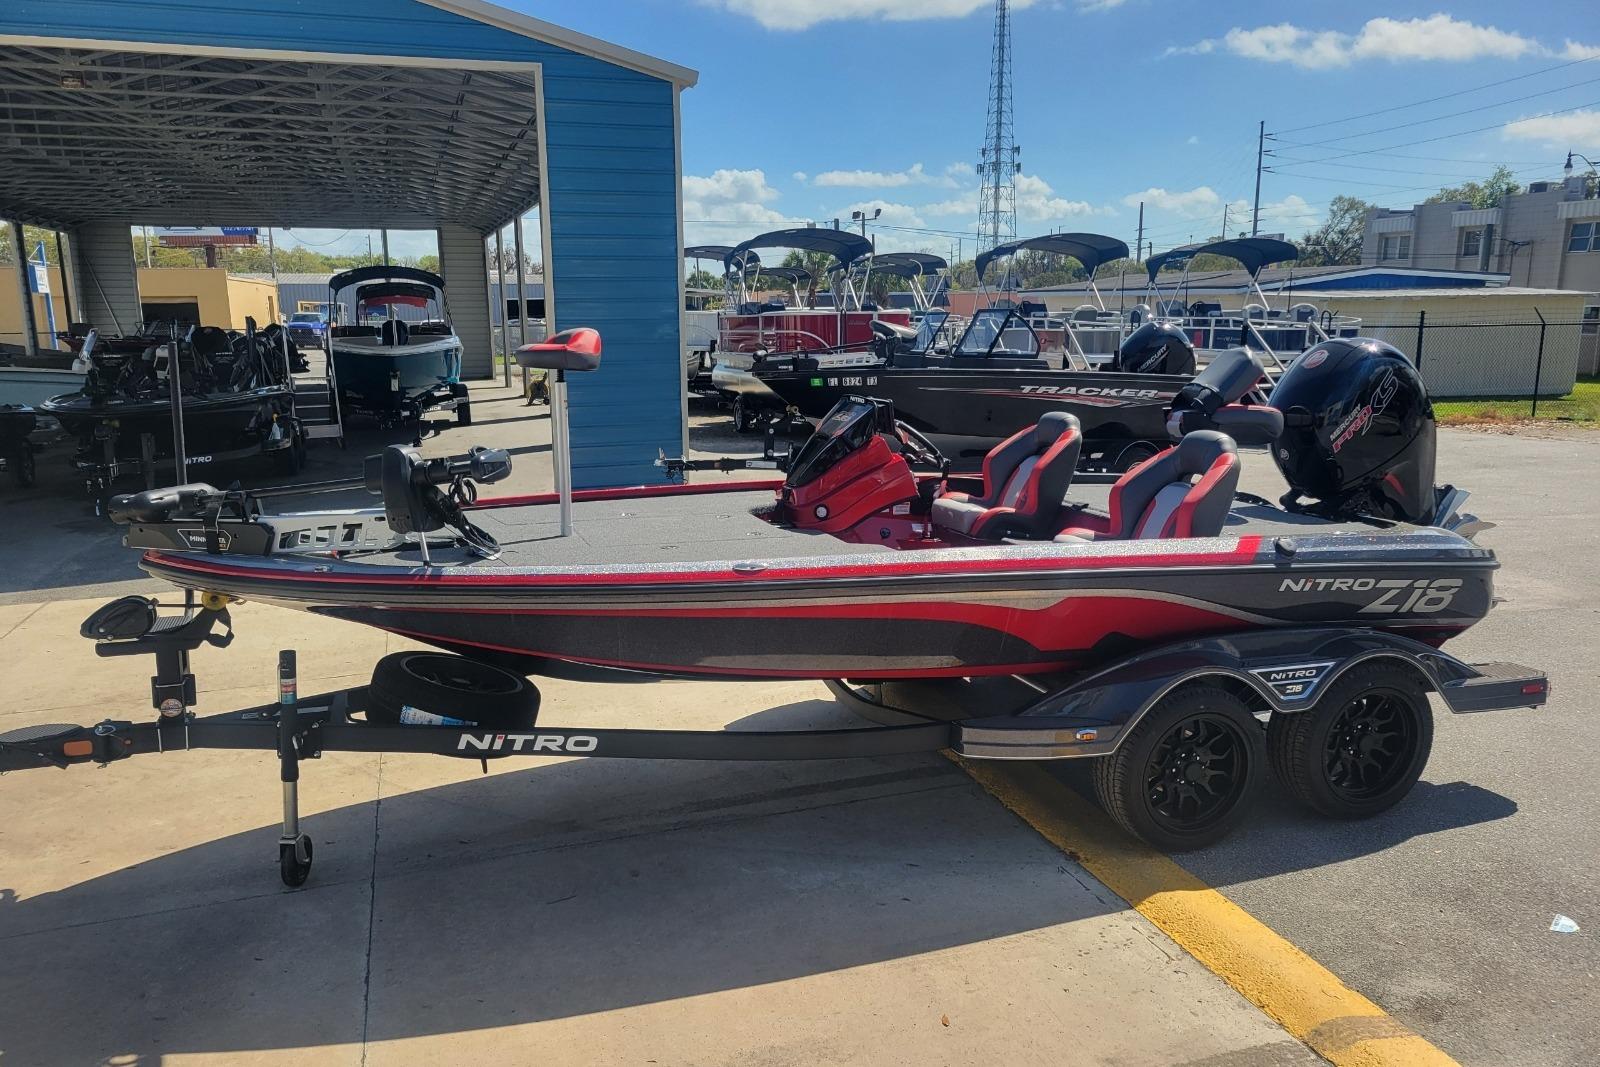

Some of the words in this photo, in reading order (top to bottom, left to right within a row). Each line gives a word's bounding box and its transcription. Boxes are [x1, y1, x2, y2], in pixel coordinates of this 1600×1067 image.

[1020, 386, 1159, 398] TRACKER
[1332, 405, 1373, 453] PRO
[1361, 367, 1399, 436] XS
[1330, 403, 1361, 441] MERCURY
[1357, 578, 1463, 613] Z18
